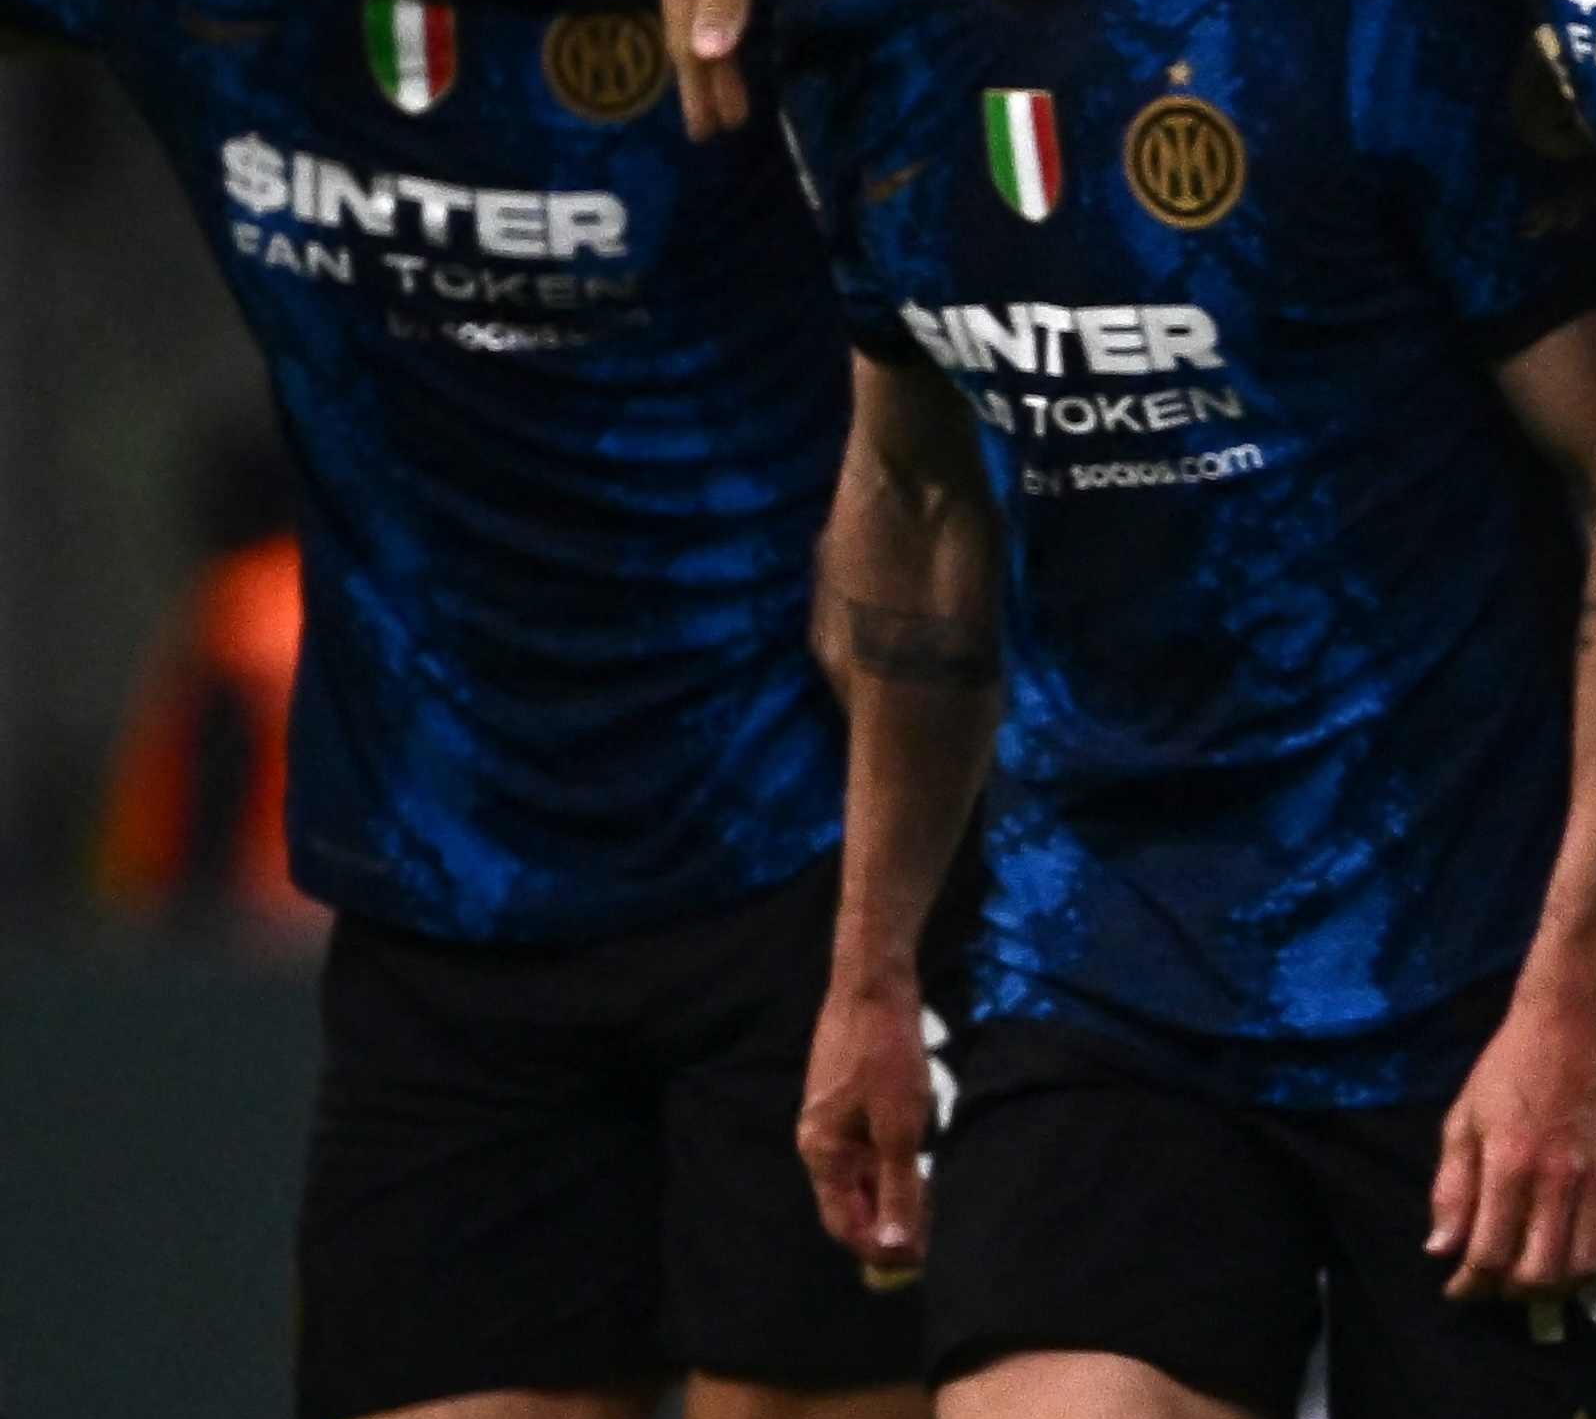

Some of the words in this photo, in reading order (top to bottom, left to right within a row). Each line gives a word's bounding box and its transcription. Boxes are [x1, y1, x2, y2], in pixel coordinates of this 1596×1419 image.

[220, 130, 630, 262] $INTER
[230, 219, 355, 285] FAN
[1021, 385, 1247, 439] TOKEN
[1068, 442, 1265, 492] socios.com
